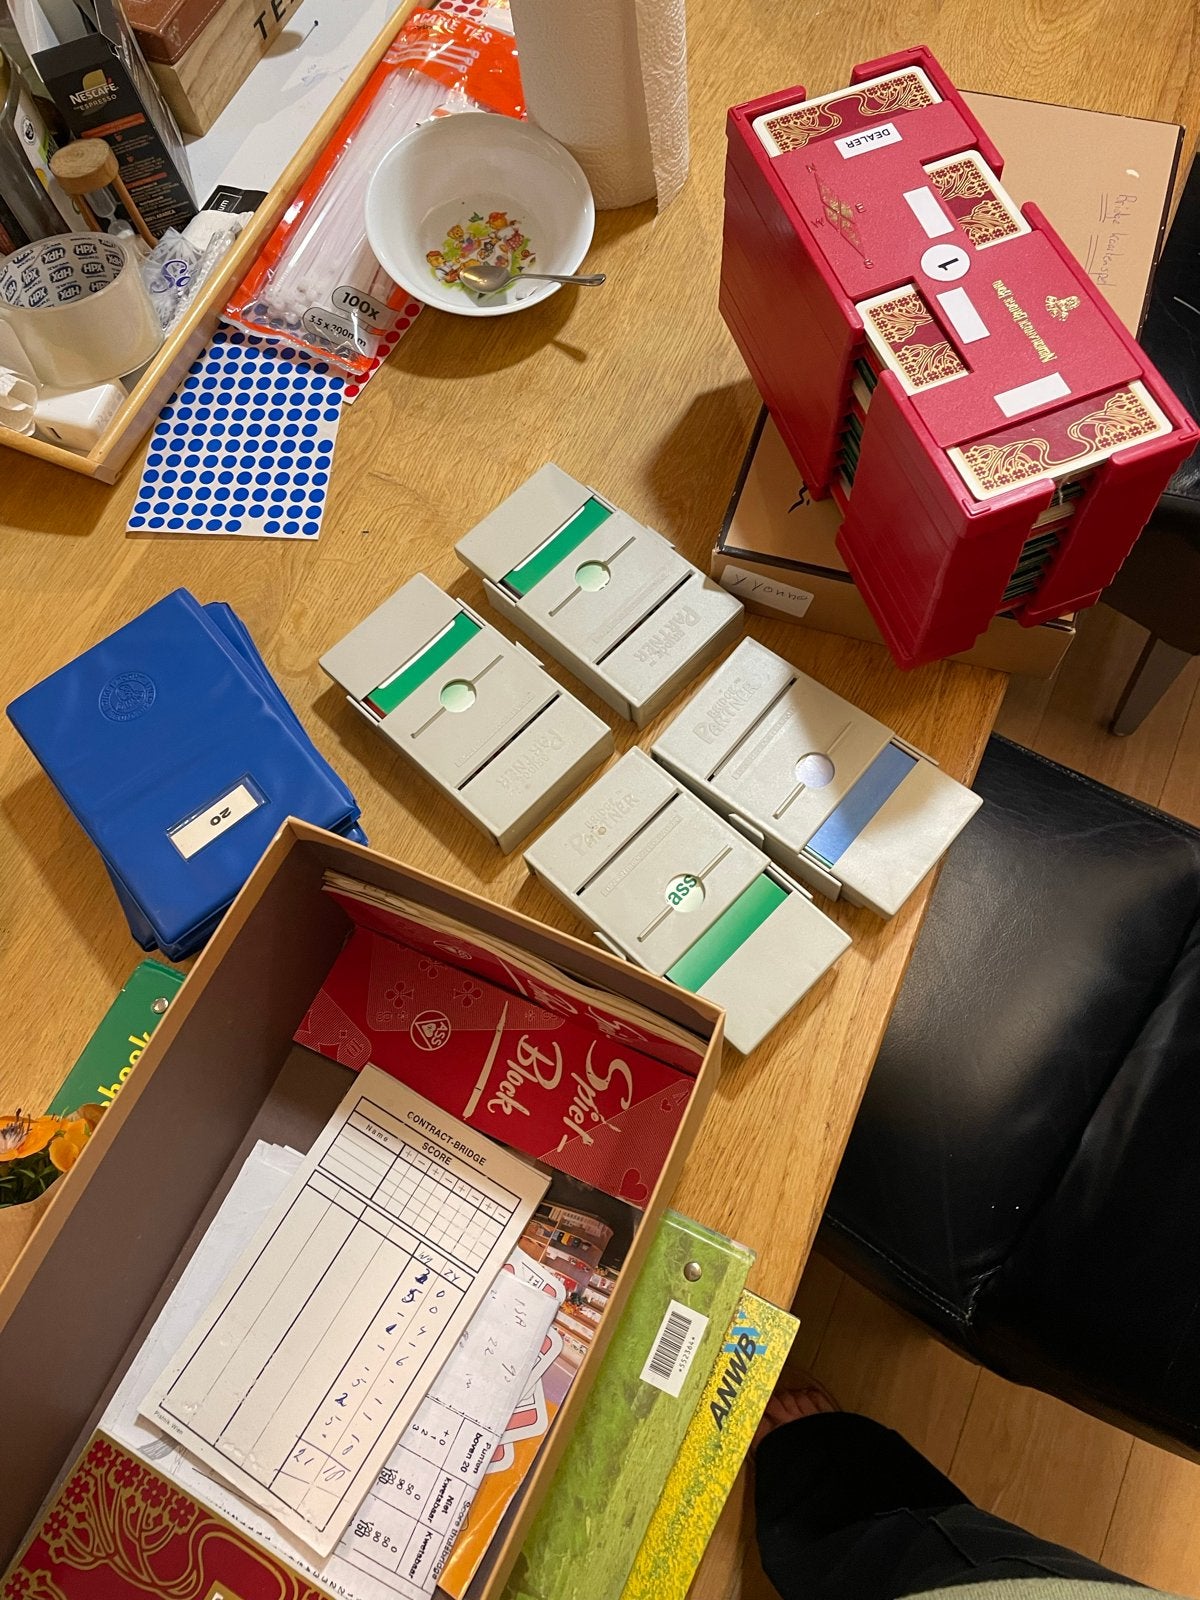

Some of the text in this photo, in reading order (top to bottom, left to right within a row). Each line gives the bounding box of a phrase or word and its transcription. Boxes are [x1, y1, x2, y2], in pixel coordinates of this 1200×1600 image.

[253, 0, 294, 40] TE
[465, 23, 493, 45] TIES
[80, 94, 117, 111] ESPRESSO
[845, 128, 891, 149] DEALER
[44, 249, 64, 263] HPX
[75, 244, 96, 255] HPX
[84, 263, 103, 273] HPX
[937, 257, 959, 271] 1
[52, 268, 72, 282] HPX
[29, 288, 47, 306] HPX
[60, 286, 80, 301] HPX
[342, 291, 381, 321] 100x
[309, 314, 323, 327] 3.5
[210, 807, 232, 826] 20
[668, 875, 698, 906] ass
[431, 1021, 448, 1046] ASS
[487, 1034, 563, 1116] Block
[365, 1124, 389, 1142] Name
[406, 1111, 487, 1166] CONTRACT-BRIDGE
[421, 1142, 453, 1166] SCORE
[710, 1332, 756, 1432] ANWB
[411, 1423, 420, 1431] 3
[420, 1428, 429, 1436] 2
[460, 1432, 483, 1474] boven 20
[405, 1482, 415, 1496] 50
[414, 1493, 421, 1501] 0
[441, 1495, 455, 1515] Niet
[454, 1501, 471, 1527] Score
[381, 1535, 391, 1548] 50
[409, 1531, 434, 1579] Kwetsbaar
